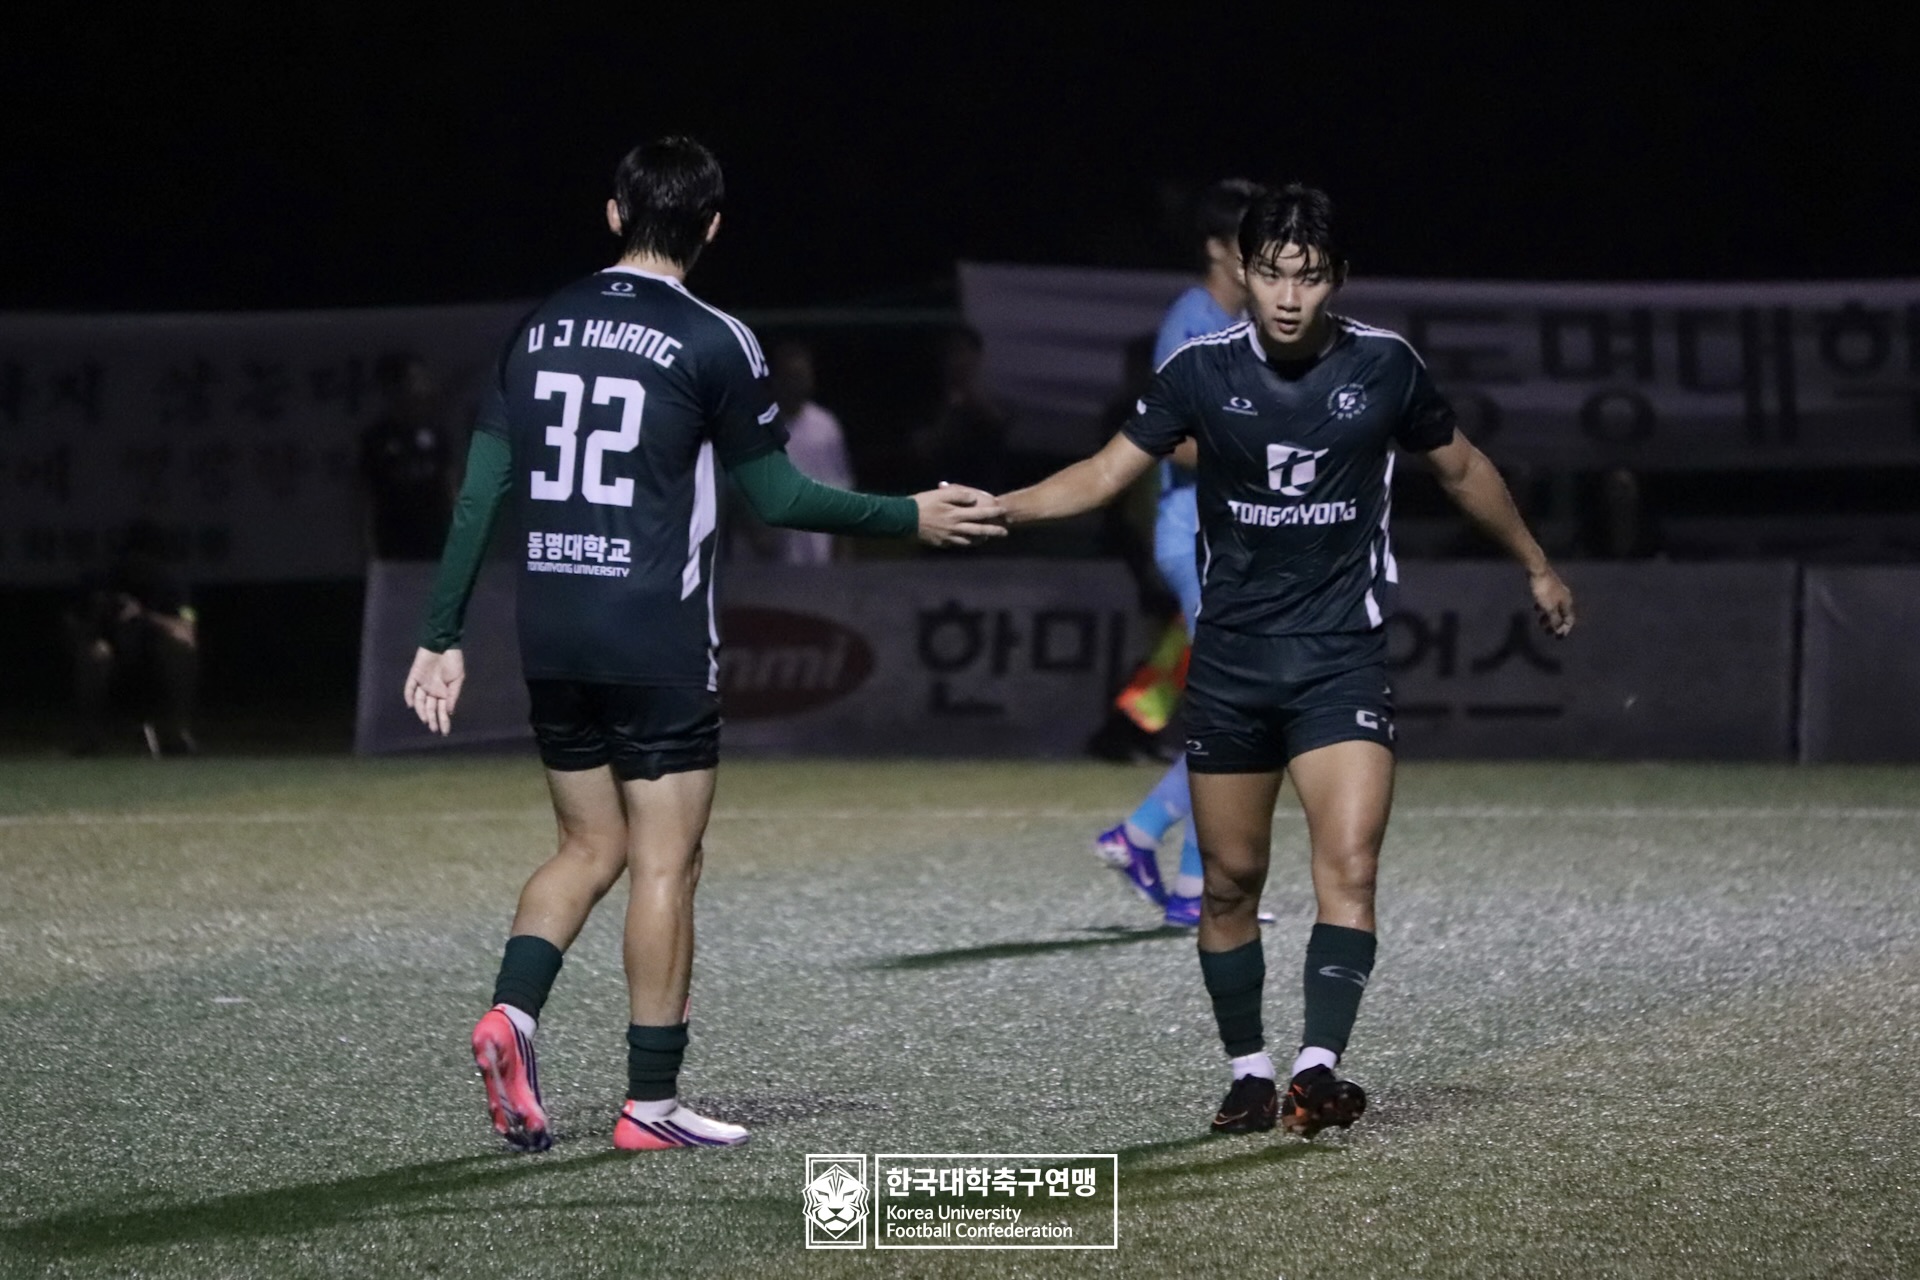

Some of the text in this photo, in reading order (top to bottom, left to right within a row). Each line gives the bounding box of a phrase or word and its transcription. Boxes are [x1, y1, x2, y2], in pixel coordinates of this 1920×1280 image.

[553, 319, 574, 347] J
[581, 319, 683, 369] HWANG
[530, 370, 646, 507] 32
[527, 532, 631, 563] 동명대학교
[573, 564, 630, 577] UNIVERSITY
